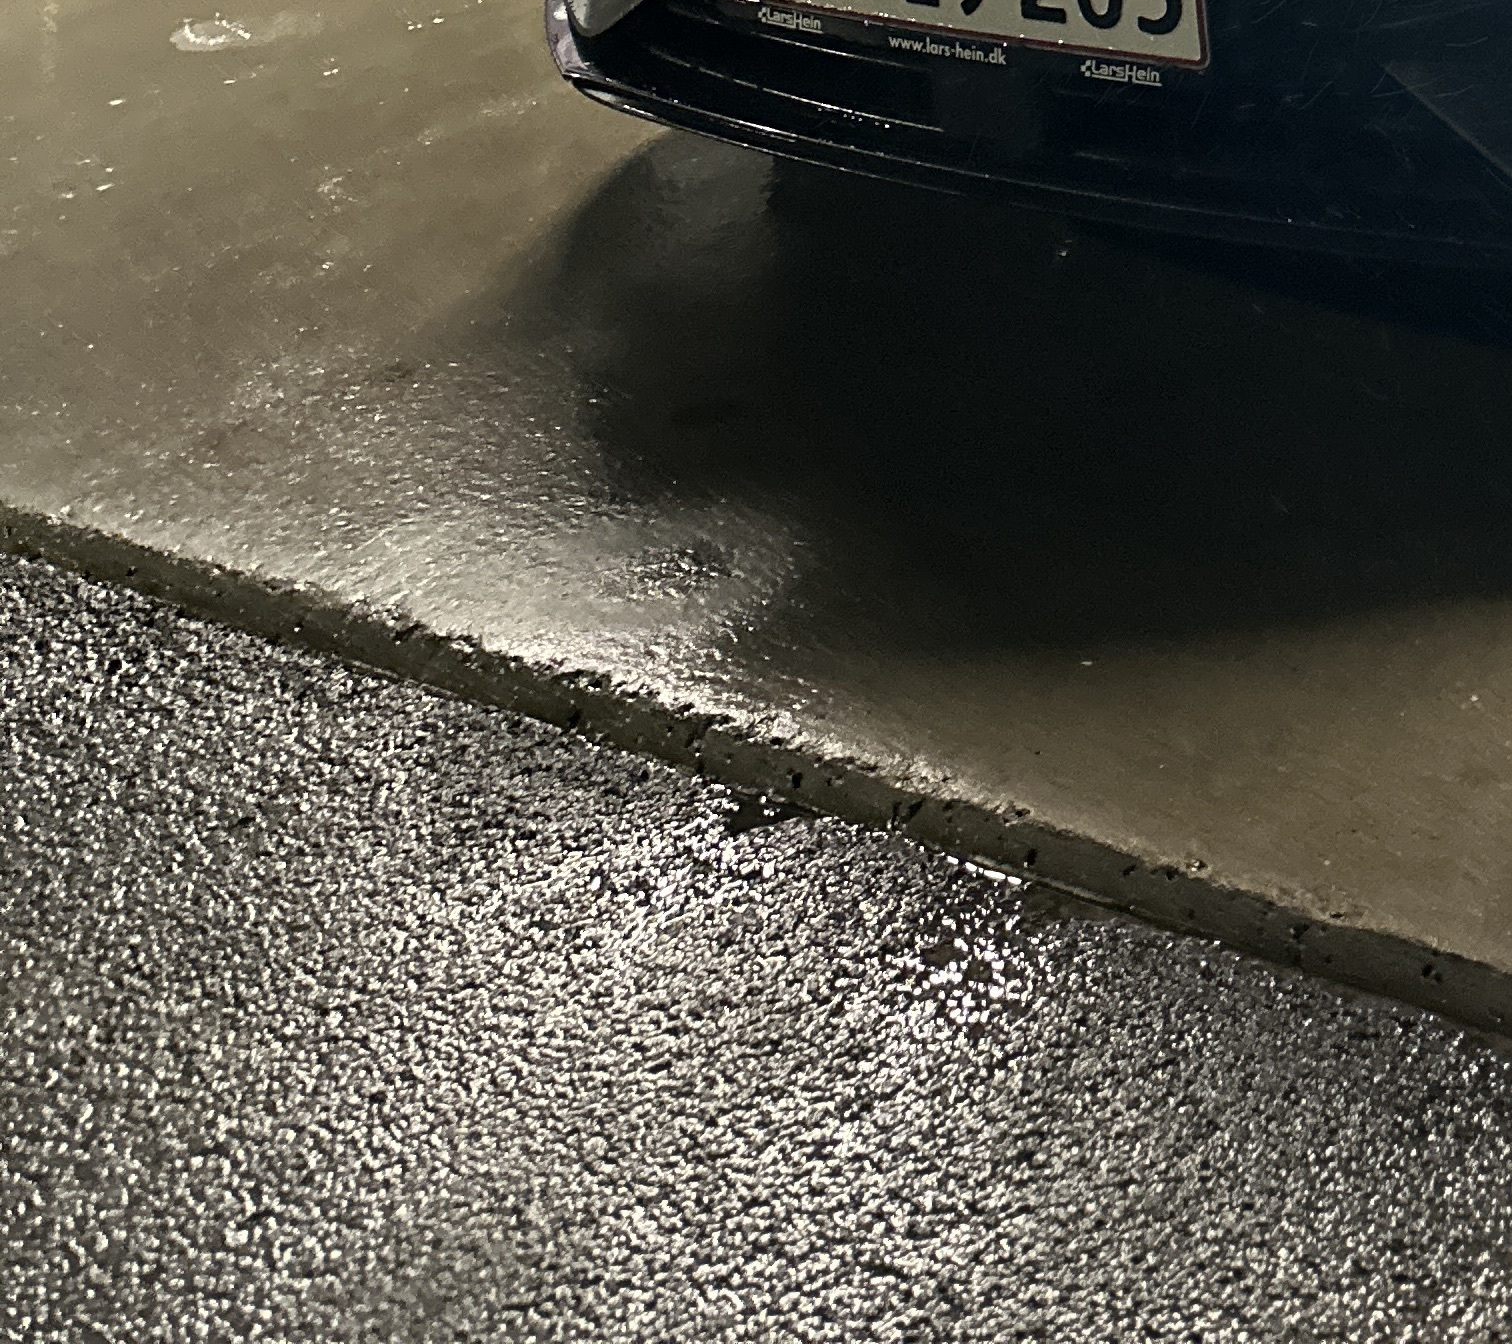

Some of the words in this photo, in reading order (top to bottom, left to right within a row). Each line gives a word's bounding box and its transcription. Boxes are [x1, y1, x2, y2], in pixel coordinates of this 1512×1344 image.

[766, 6, 823, 33] LarsHein
[888, 35, 1007, 65] www.lars-hein.dk
[1090, 59, 1161, 85] LarsHein
